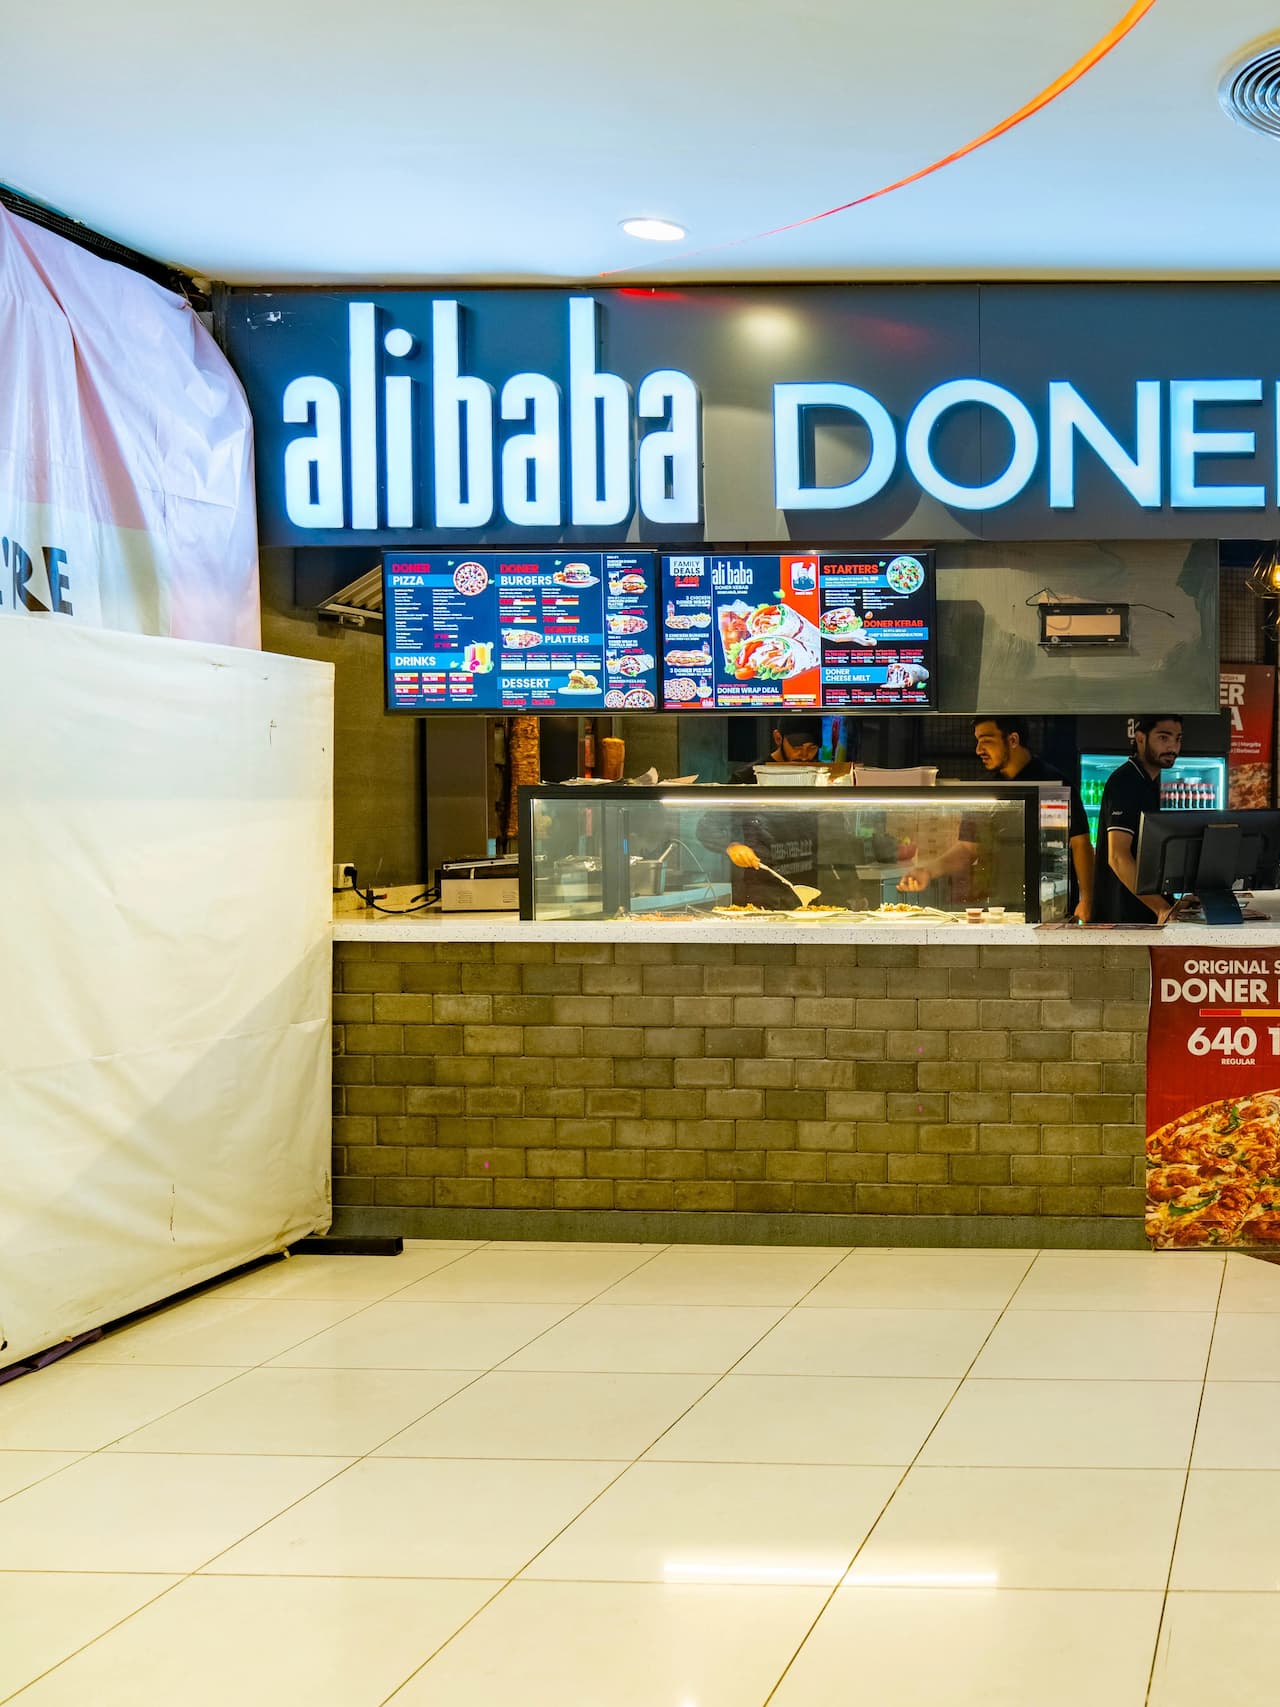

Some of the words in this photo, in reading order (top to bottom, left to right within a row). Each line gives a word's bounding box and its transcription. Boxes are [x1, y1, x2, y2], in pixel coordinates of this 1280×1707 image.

[824, 564, 878, 574] STARTERS
[0, 536, 73, 616] 'RE
[393, 576, 424, 586] PIZZA
[501, 576, 552, 586] BURGERS
[864, 620, 894, 628] DONER
[545, 636, 589, 644] PLATTERS
[395, 656, 436, 666] DRINKS
[502, 679, 550, 688] DESSERT
[1184, 960, 1269, 975] ORIGINAL
[1160, 978, 1269, 1003] DONER
[1187, 1026, 1258, 1056] 640
[1221, 1058, 1256, 1066] REGULAR
